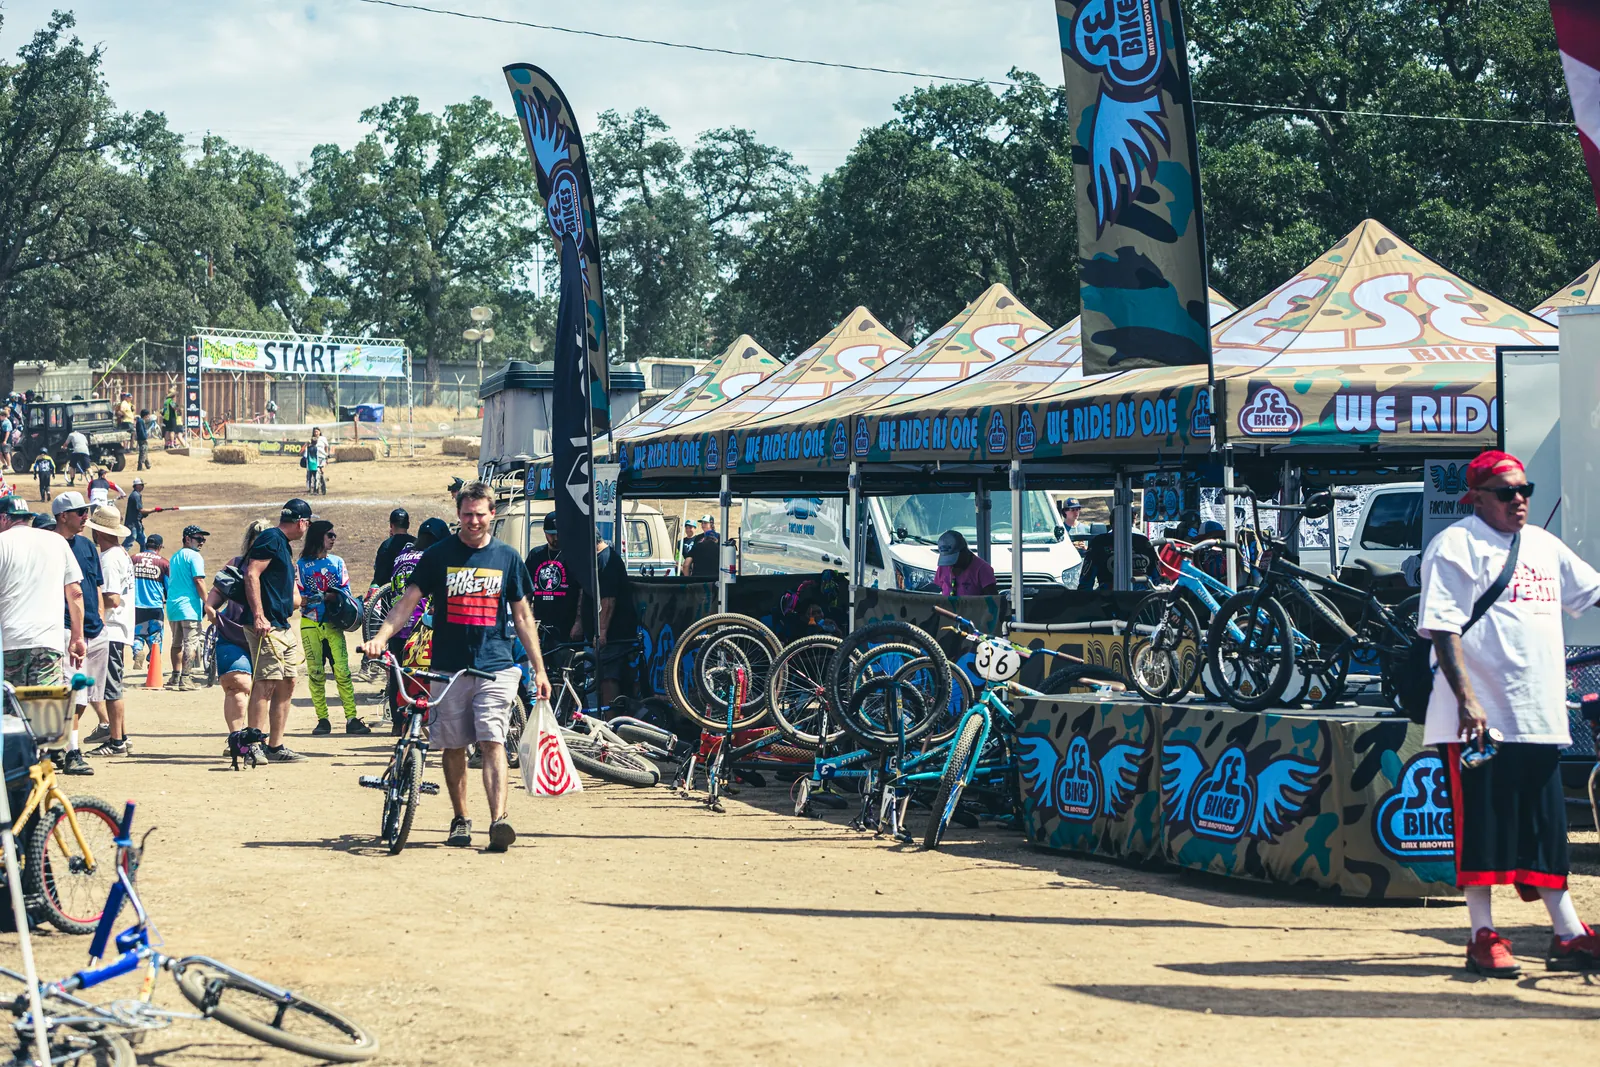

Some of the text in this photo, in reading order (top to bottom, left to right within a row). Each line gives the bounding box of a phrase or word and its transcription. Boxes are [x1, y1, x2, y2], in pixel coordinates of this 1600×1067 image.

[1117, 0, 1144, 58] BIKE
[1147, 37, 1156, 56] BMX
[264, 341, 341, 373] START
[1408, 346, 1497, 362] BIKE
[1255, 393, 1286, 413] SE
[1335, 394, 1398, 433] WE
[879, 417, 978, 450] WE RIDE AS ONE
[1047, 399, 1177, 444] WE RIDE AS ONE
[1253, 414, 1288, 426] BIKES
[633, 445, 647, 470] WE
[648, 442, 669, 468] RIDE
[669, 441, 680, 467] AS
[681, 440, 700, 467] ONE
[745, 436, 760, 463] WE
[762, 432, 788, 461] RIDE
[789, 431, 801, 459] AS
[803, 429, 825, 458] ONE
[446, 567, 478, 586] BMX
[447, 575, 503, 597] MUSEUM
[979, 646, 1009, 675] 36
[1067, 744, 1088, 780] SE
[1210, 756, 1242, 796] SE
[1065, 781, 1089, 804] BIKES
[1405, 767, 1450, 810] SE
[1203, 794, 1240, 820] BIKES
[1403, 812, 1453, 836] BIKE
[1419, 841, 1454, 849] INNOVATI
